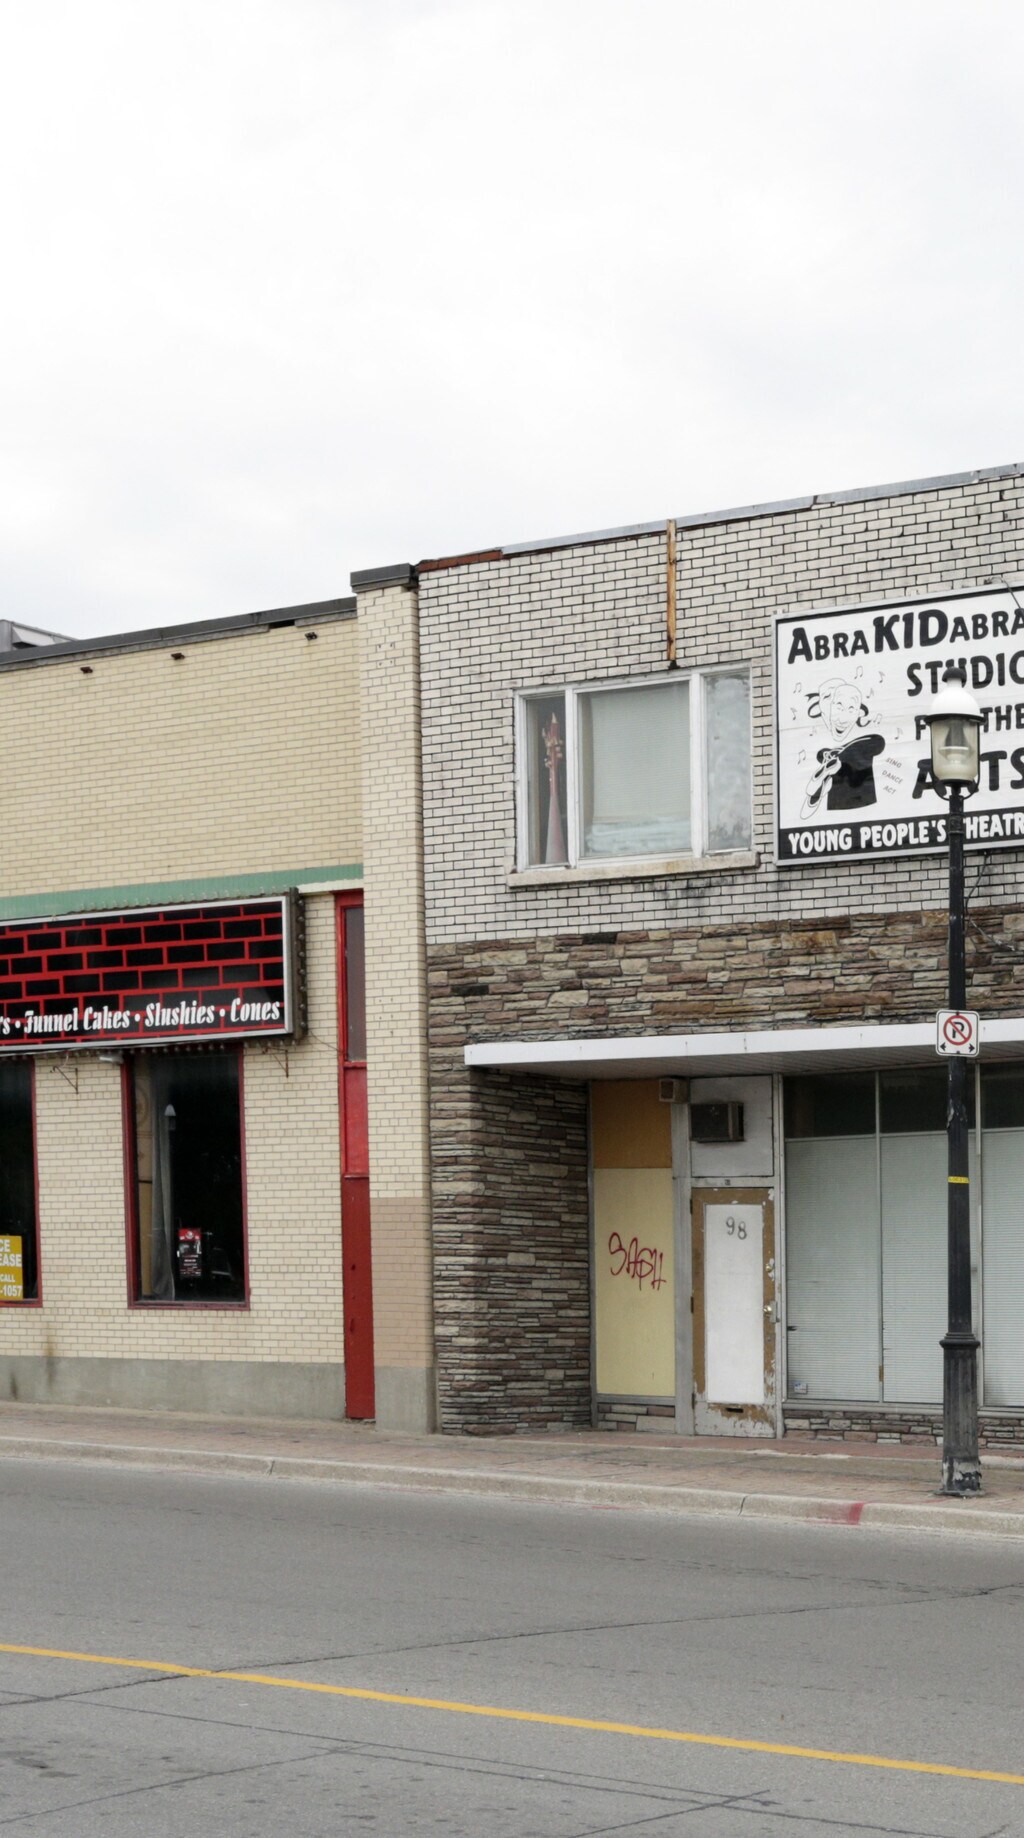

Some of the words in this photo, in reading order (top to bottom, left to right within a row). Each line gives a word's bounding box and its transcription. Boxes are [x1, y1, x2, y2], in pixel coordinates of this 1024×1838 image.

[788, 828, 852, 855] YOUNG
[860, 818, 947, 849] PEOPLE'S
[24, 1007, 79, 1034] Funnel
[83, 1005, 131, 1031] Cakes
[144, 999, 215, 1027] Slushies
[230, 997, 281, 1023] Cones
[726, 1216, 748, 1240] 98
